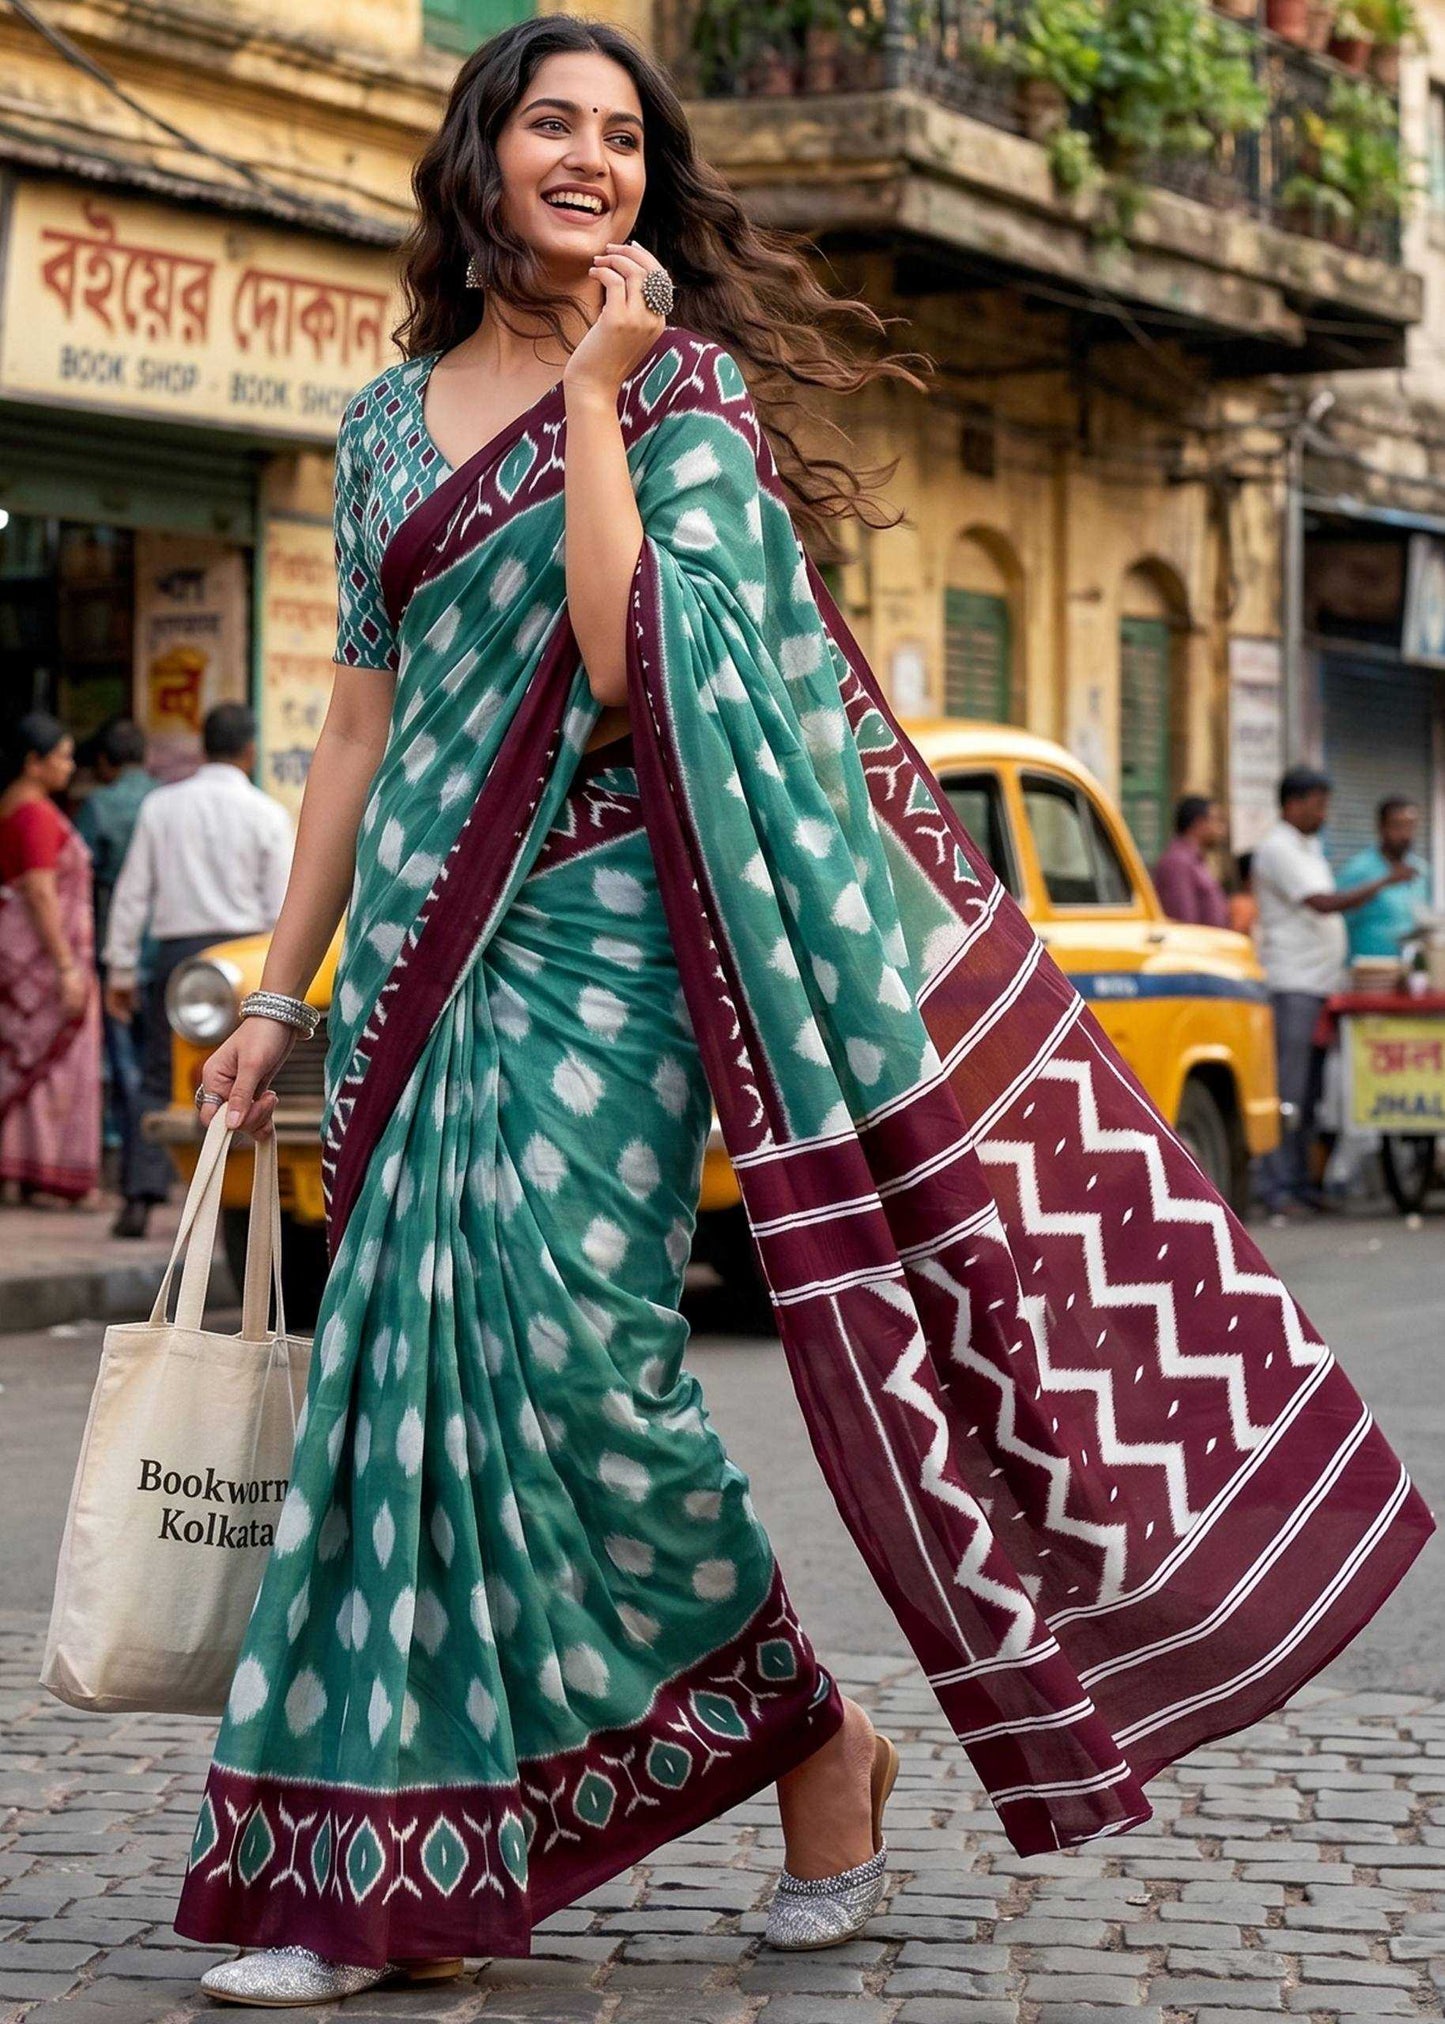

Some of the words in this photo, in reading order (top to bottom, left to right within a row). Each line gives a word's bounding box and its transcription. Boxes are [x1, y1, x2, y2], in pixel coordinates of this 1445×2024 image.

[41, 200, 215, 347] বইয়ের
[233, 269, 391, 369] দোকান
[60, 345, 126, 382] BOOK
[137, 360, 200, 397] SHOP
[229, 372, 290, 407] BOOK
[158, 1508, 274, 1549] Kolkata
